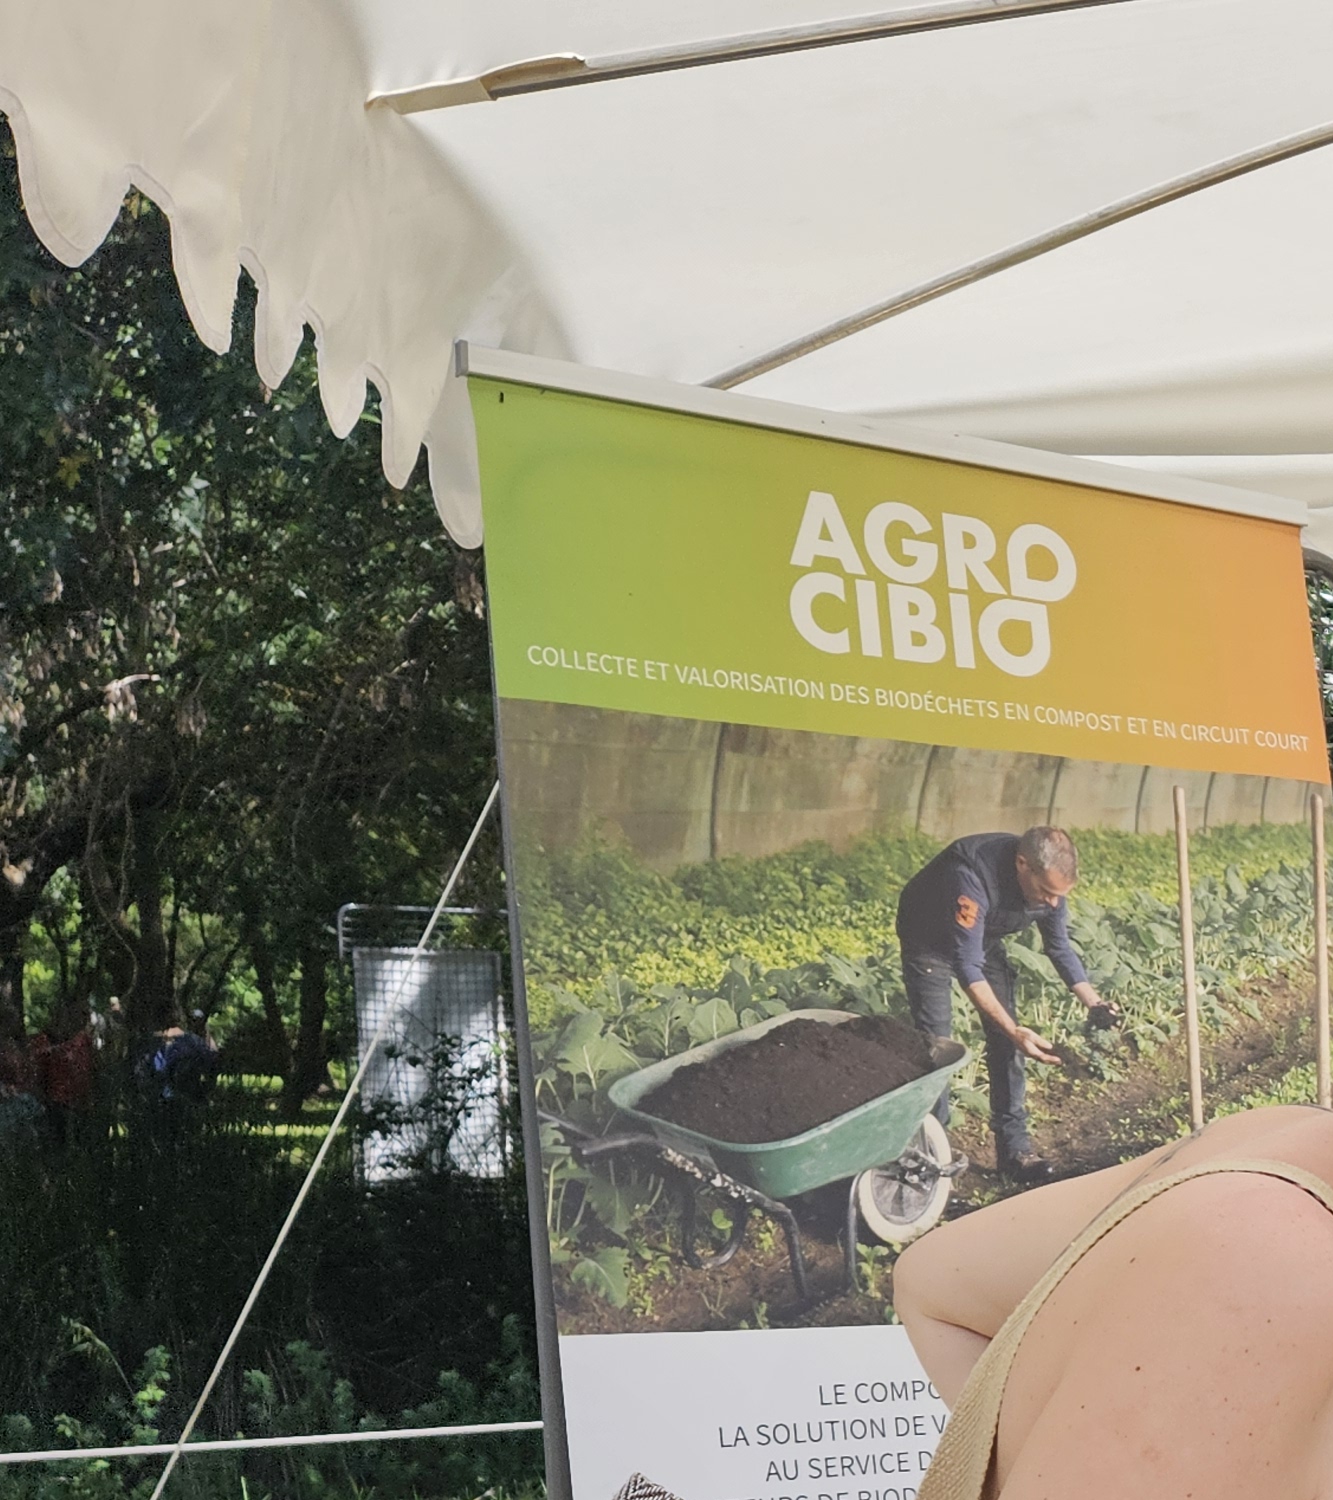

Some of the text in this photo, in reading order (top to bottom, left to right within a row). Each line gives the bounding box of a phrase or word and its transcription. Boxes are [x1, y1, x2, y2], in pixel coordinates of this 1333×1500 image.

[789, 490, 1077, 602] AGRO
[789, 571, 1051, 677] CIBIO
[526, 644, 1310, 752] COLLECTE ET VALORISATION DES BIODÉCHETS EN COMPOST ET EN CIRCUIT COURT
[818, 1384, 848, 1406] LE
[718, 1425, 751, 1449] LA
[756, 1417, 887, 1446] SOLUTION
[894, 1415, 927, 1438] DE
[765, 1459, 799, 1483] AU
[807, 1452, 911, 1479] SERVICE
